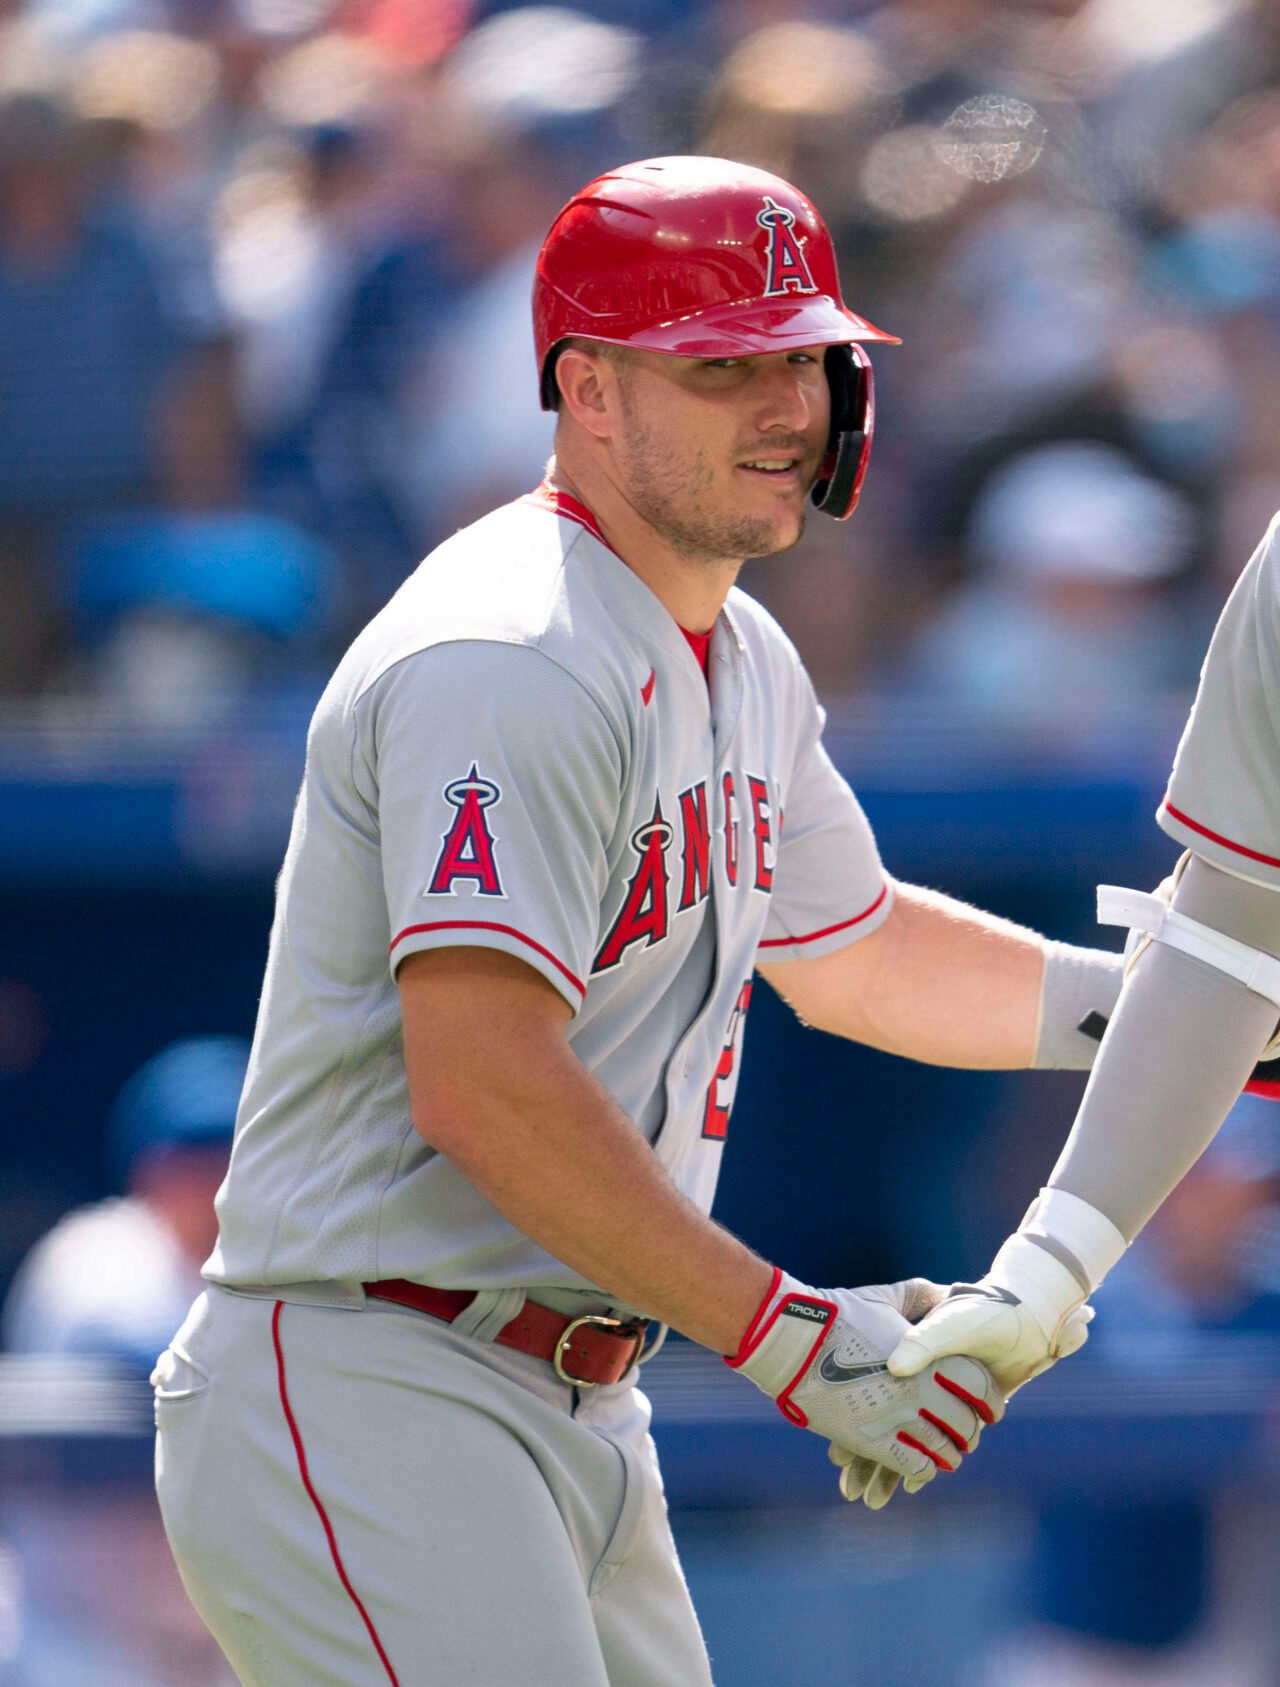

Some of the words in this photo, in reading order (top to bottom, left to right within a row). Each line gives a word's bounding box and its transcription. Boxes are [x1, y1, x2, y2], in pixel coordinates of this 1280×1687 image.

[756, 196, 819, 298] A
[422, 760, 509, 900] A
[588, 768, 784, 979] ANGE
[788, 1303, 828, 1320] TROUT
